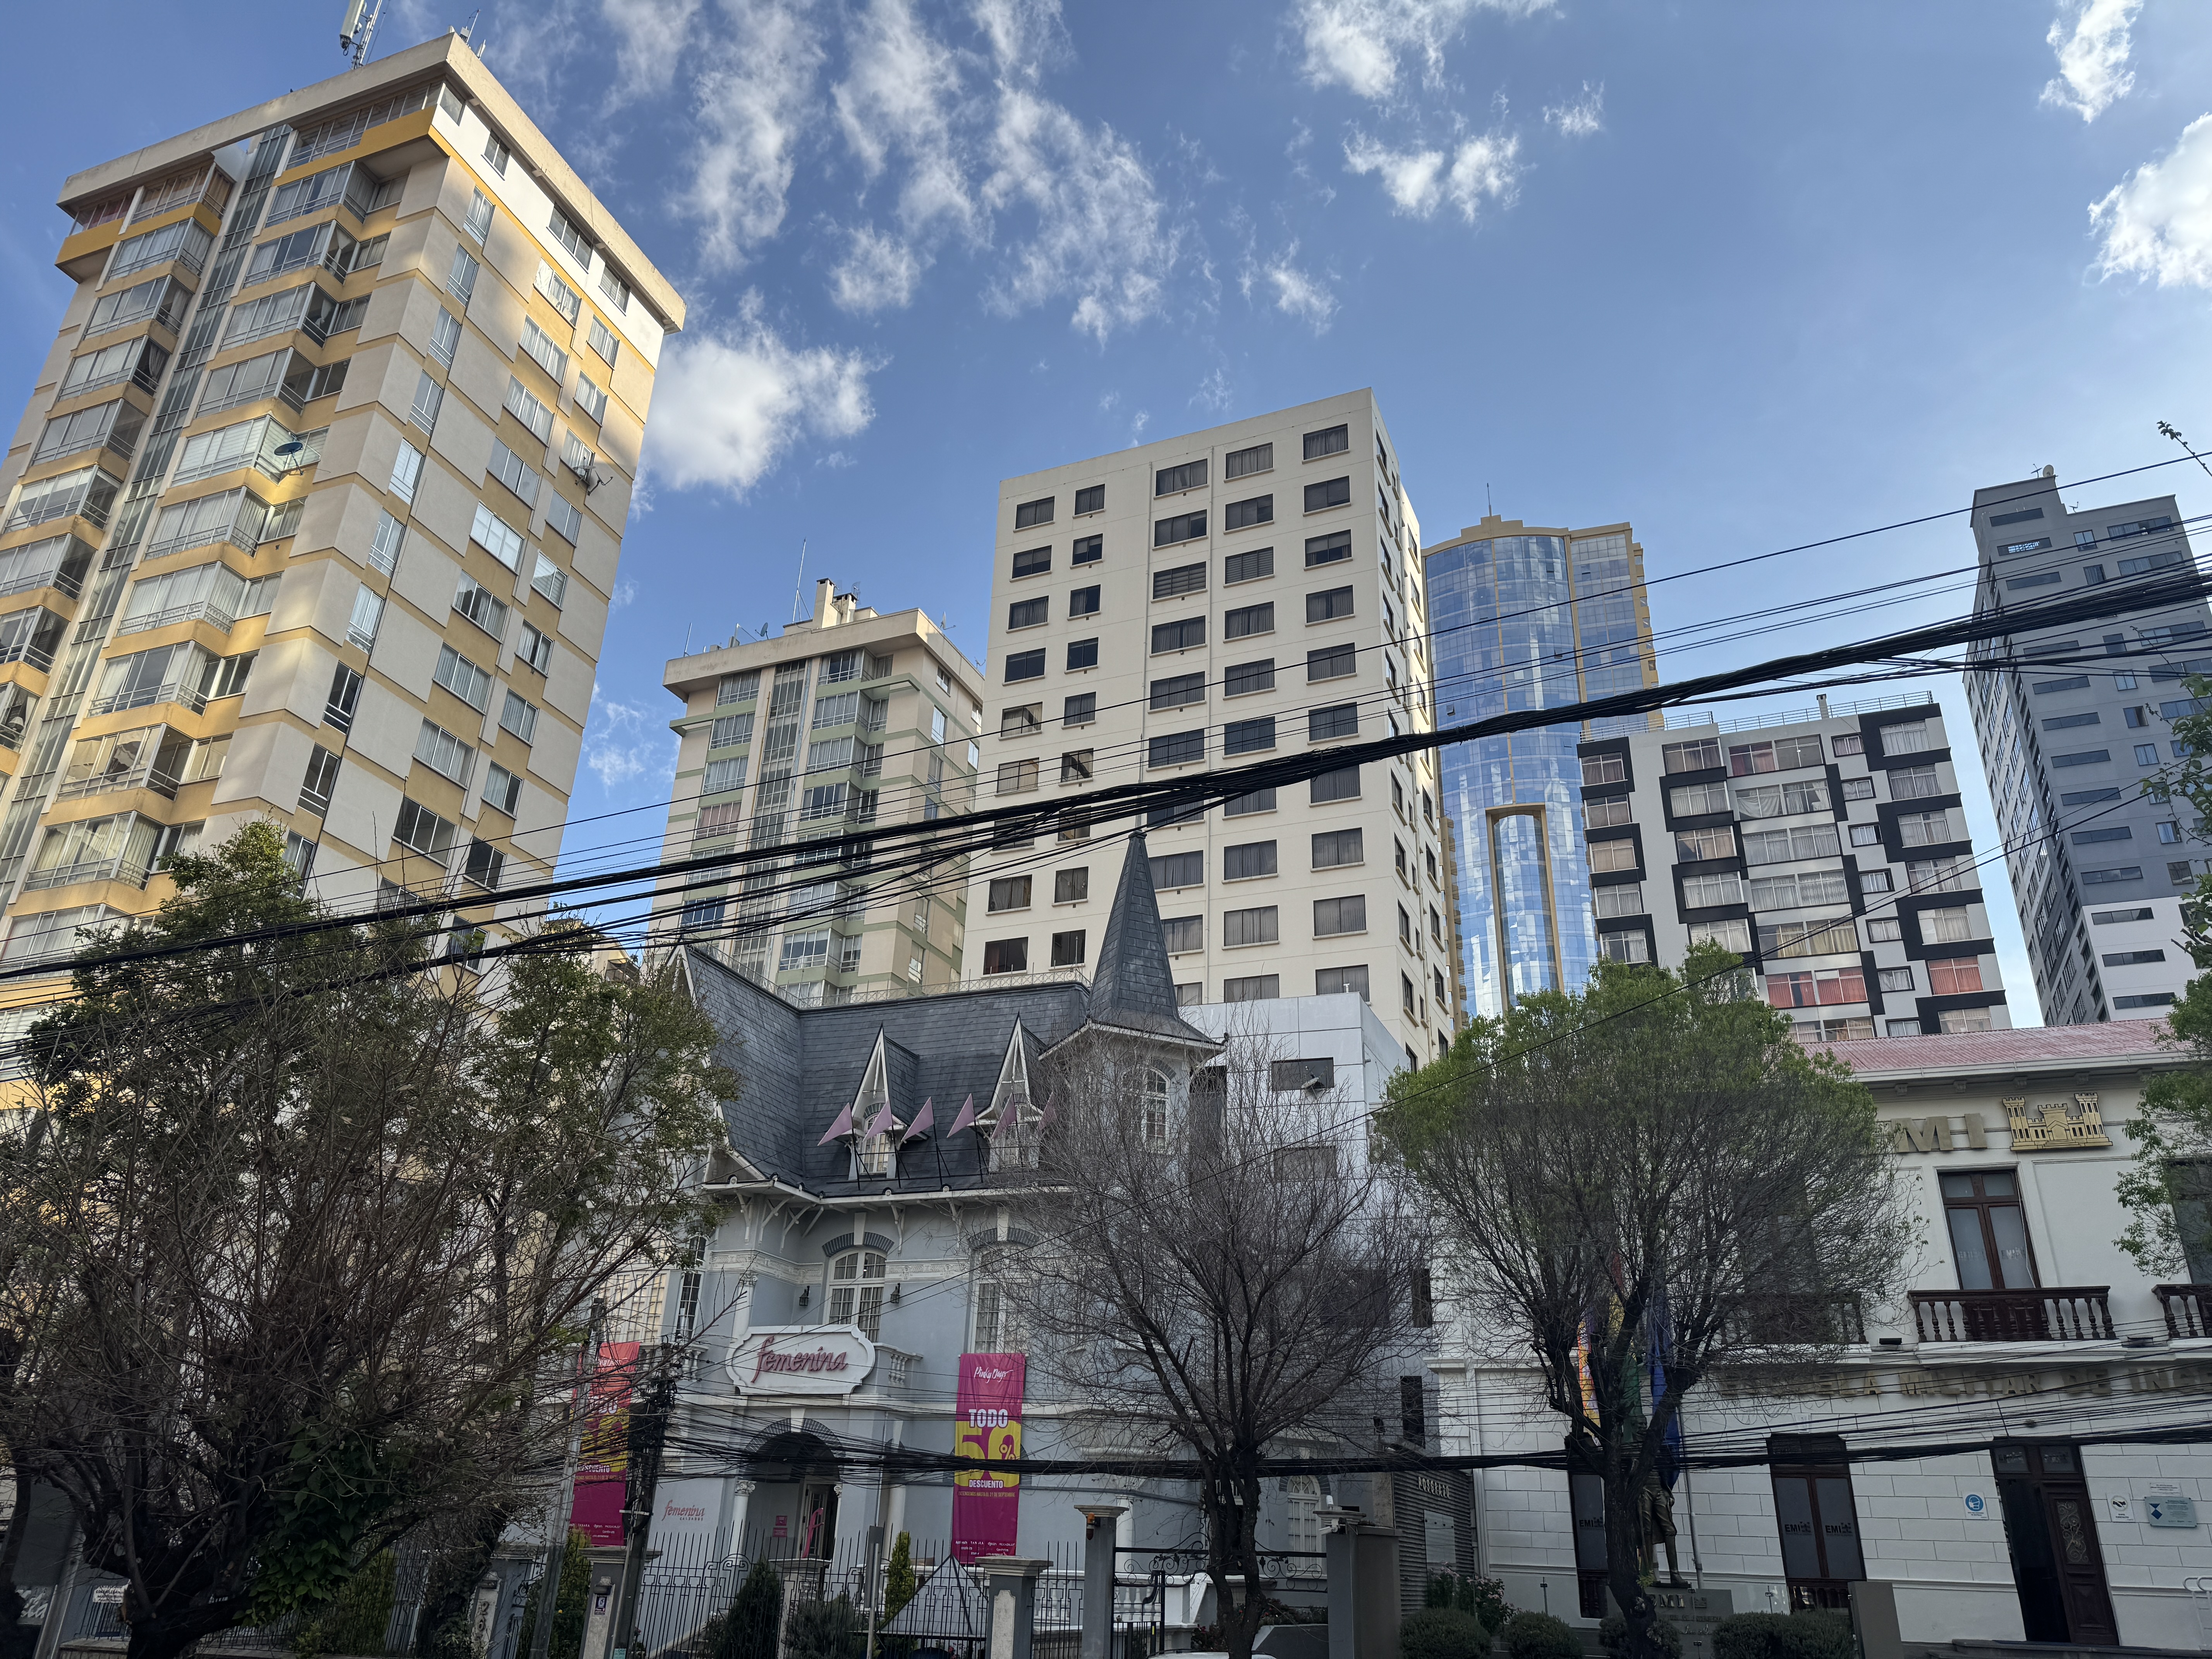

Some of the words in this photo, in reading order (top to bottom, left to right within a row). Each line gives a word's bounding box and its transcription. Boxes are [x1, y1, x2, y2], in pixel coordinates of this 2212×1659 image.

[1890, 1113, 1987, 1153] MI
[750, 1336, 848, 1384] femenina
[974, 1366, 992, 1383] Pinky
[992, 1368, 1013, 1382] Days
[1719, 1370, 1882, 1395] EELA
[2061, 1368, 2112, 1395] DE
[969, 1409, 1008, 1428] TODO
[969, 1480, 1004, 1488] DESCUENTO
[1418, 1476, 1450, 1499] POSGRADO
[661, 1499, 705, 1521] femenina
[1579, 1519, 1594, 1527] EMI
[1784, 1524, 1800, 1532] EMI
[1825, 1525, 1842, 1533] EMI
